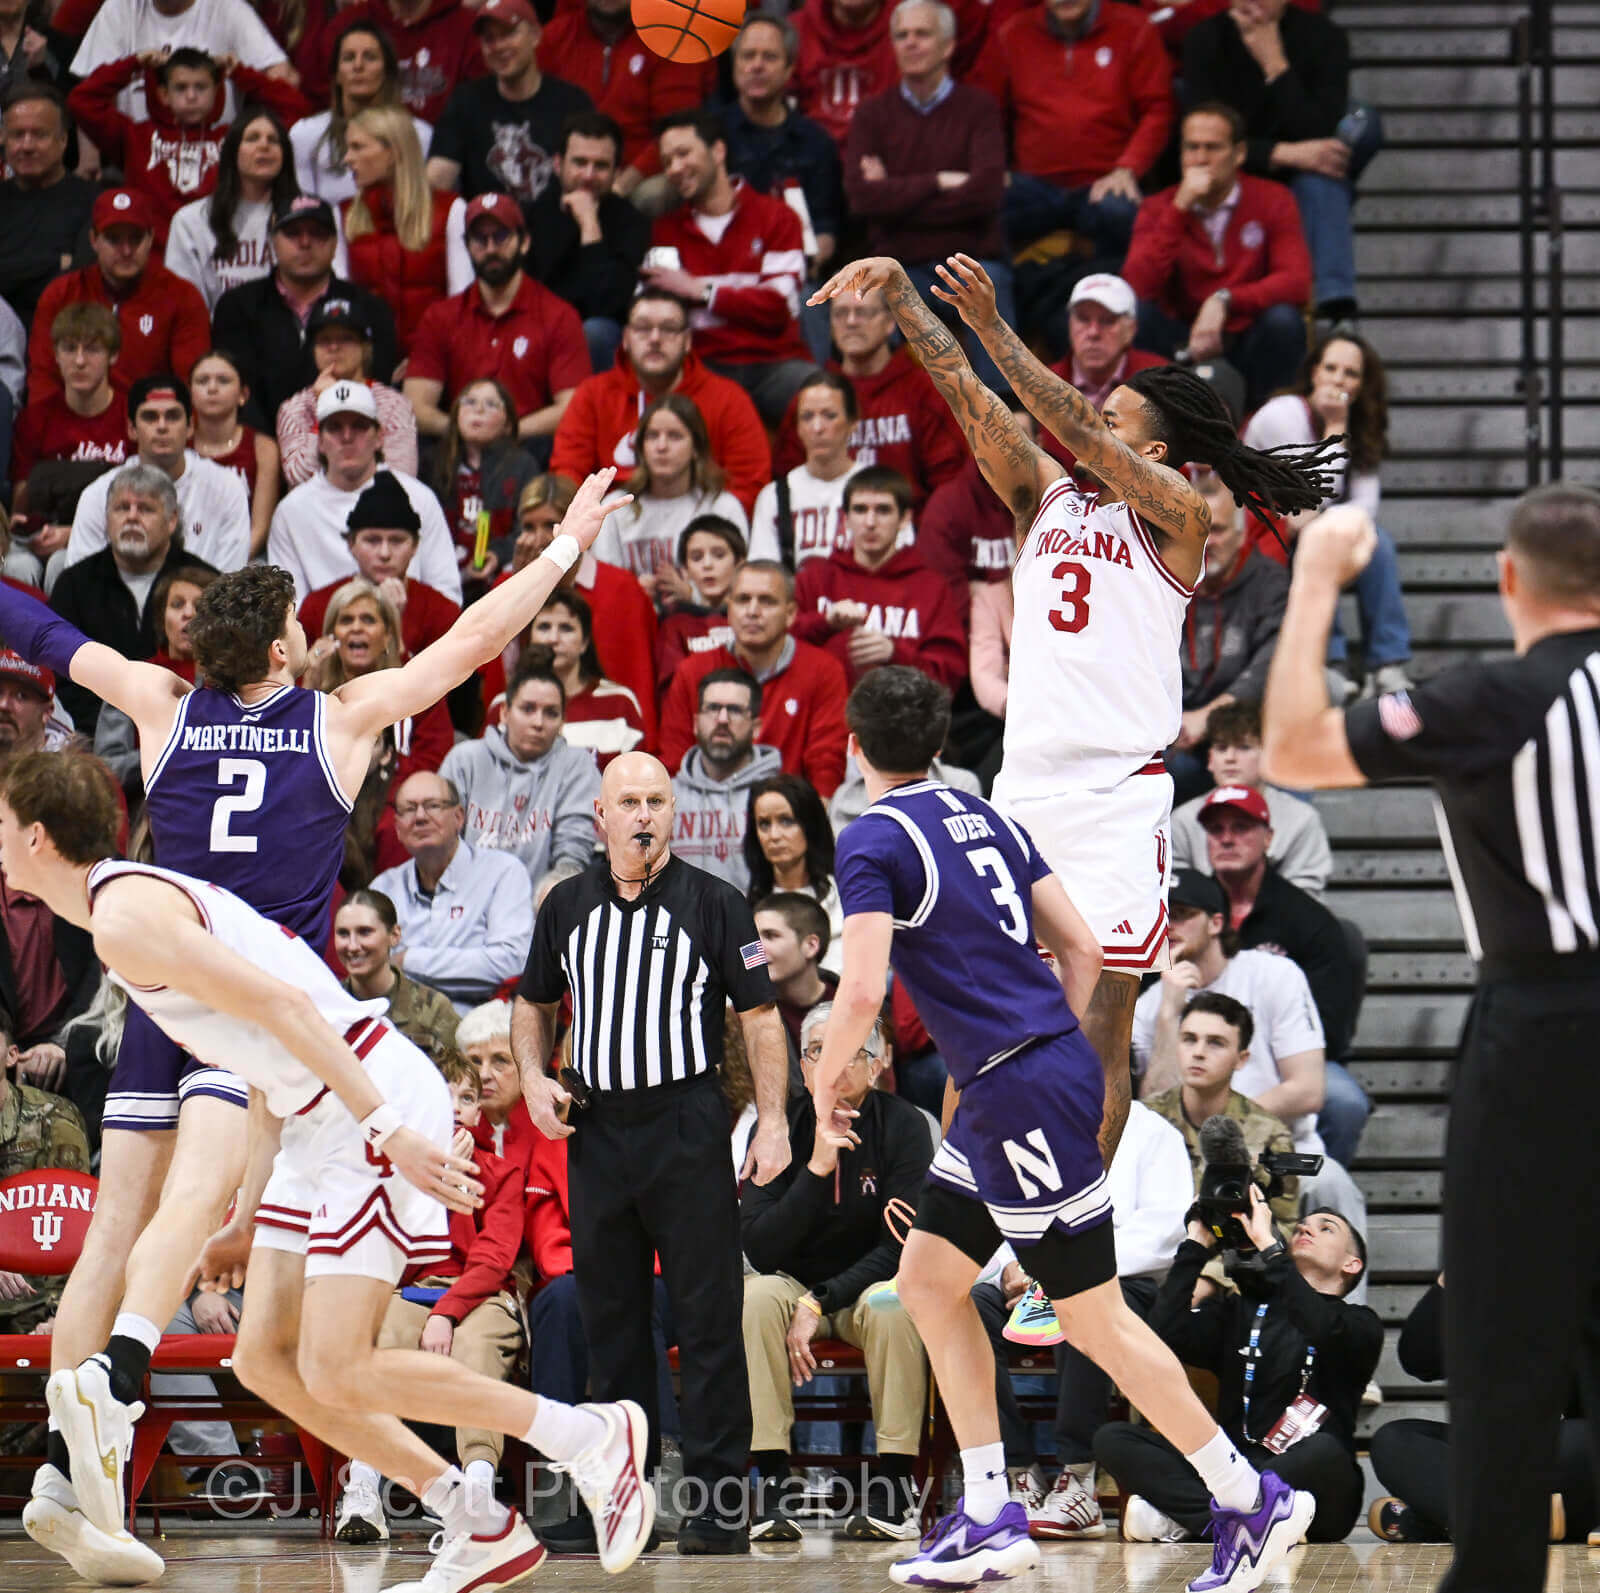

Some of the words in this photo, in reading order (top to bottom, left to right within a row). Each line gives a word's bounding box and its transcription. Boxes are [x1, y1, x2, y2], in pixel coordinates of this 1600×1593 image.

[1036, 526, 1134, 570] NDIANA
[1048, 561, 1092, 633] 3
[181, 725, 310, 753] MARTINELLI
[209, 758, 267, 853] 2
[942, 813, 996, 844] WEST
[965, 846, 1029, 945] 3
[651, 936, 670, 948] TW
[0, 1183, 97, 1213] NDIAN
